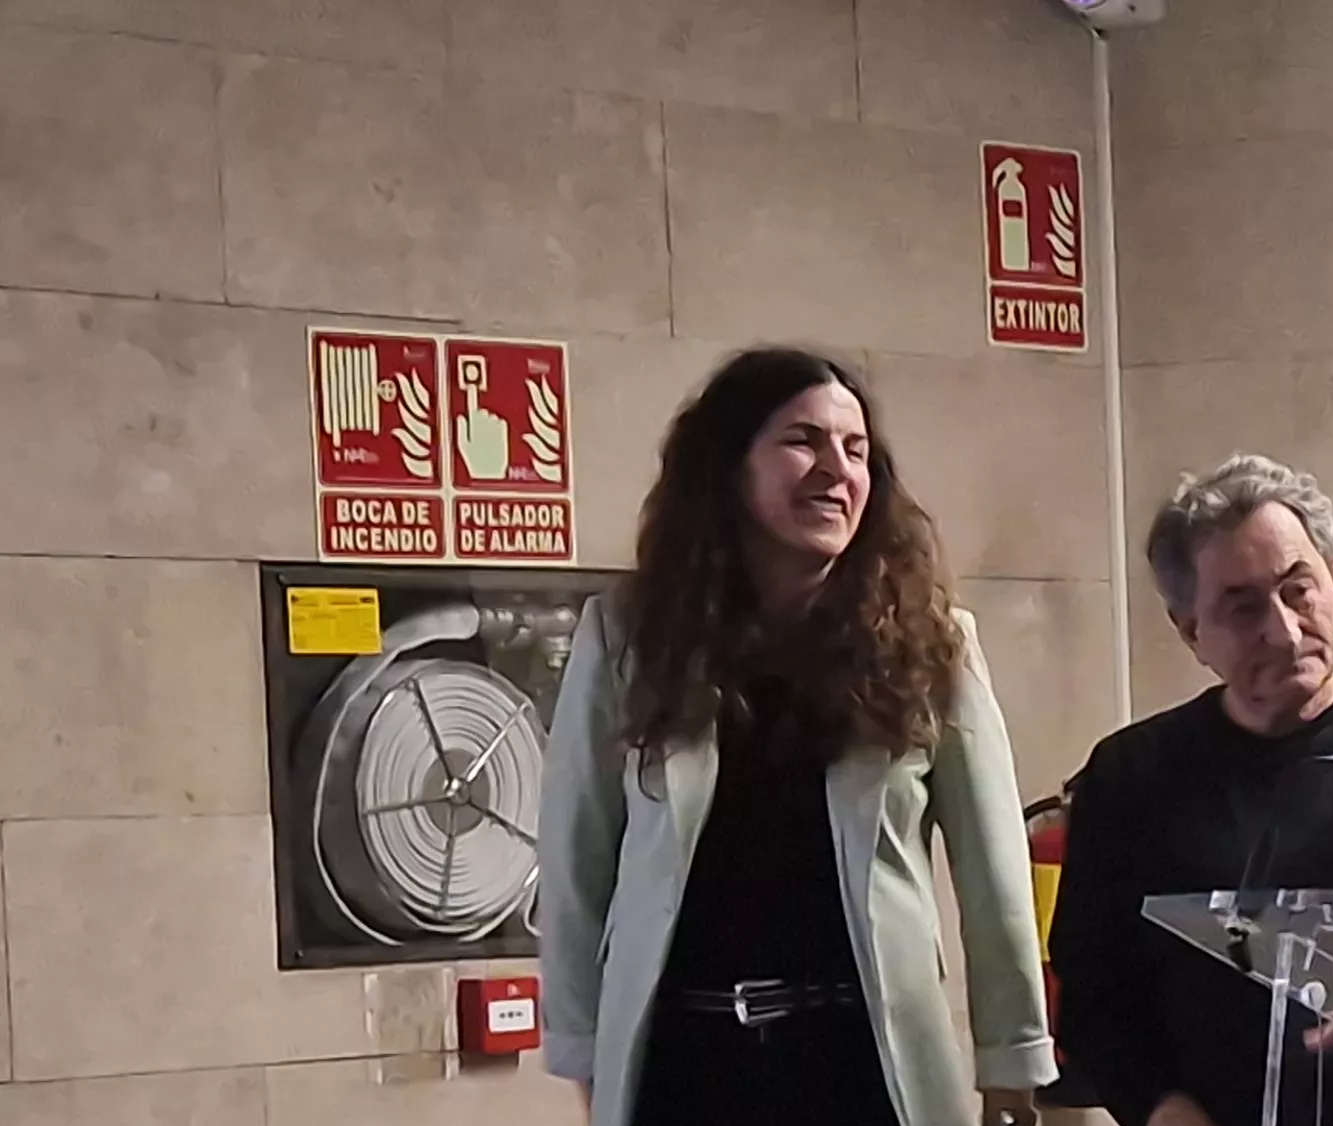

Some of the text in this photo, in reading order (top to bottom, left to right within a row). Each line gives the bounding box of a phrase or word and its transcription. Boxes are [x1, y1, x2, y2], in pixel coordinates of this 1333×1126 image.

[994, 297, 1081, 334] EXTINTOR
[336, 499, 430, 525] BOCA DE
[459, 503, 565, 528] PULSADOR
[331, 526, 437, 552] INCENDIO
[461, 530, 566, 553] DE ALARMA
